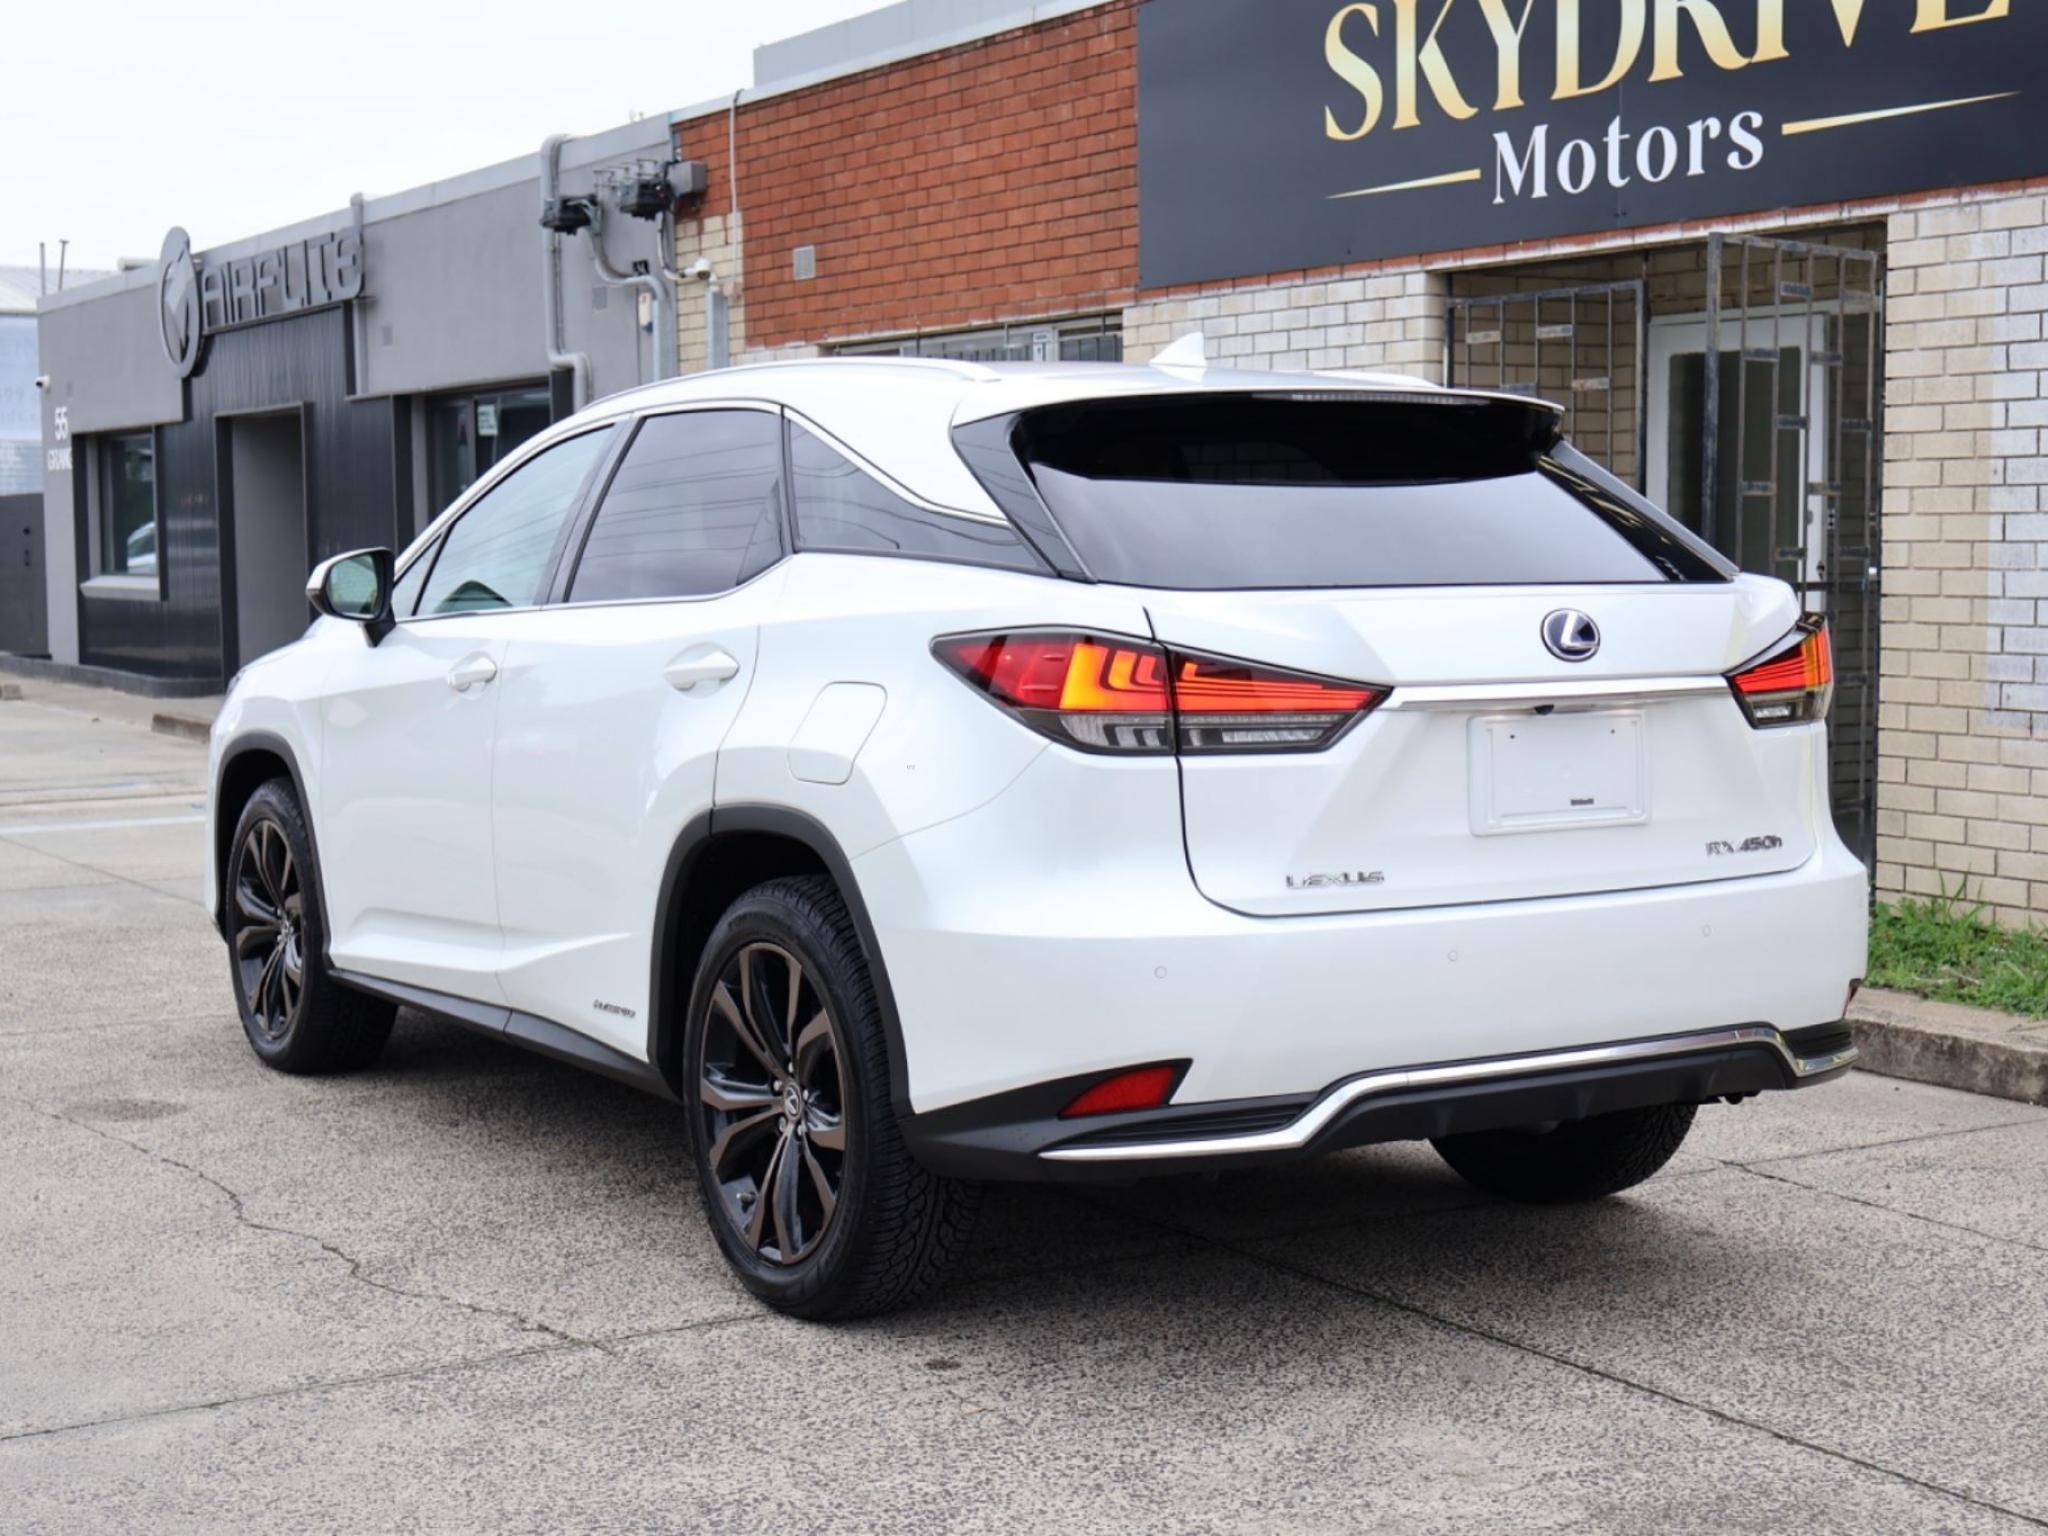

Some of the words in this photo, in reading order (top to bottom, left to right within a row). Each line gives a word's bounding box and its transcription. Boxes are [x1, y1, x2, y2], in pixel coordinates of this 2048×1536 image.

[1324, 0, 2010, 141] SKYDR
[1493, 111, 1765, 204] Motors
[201, 226, 364, 329] AIRFLITE
[54, 406, 69, 440] 55
[1285, 870, 1385, 890] LEXUS
